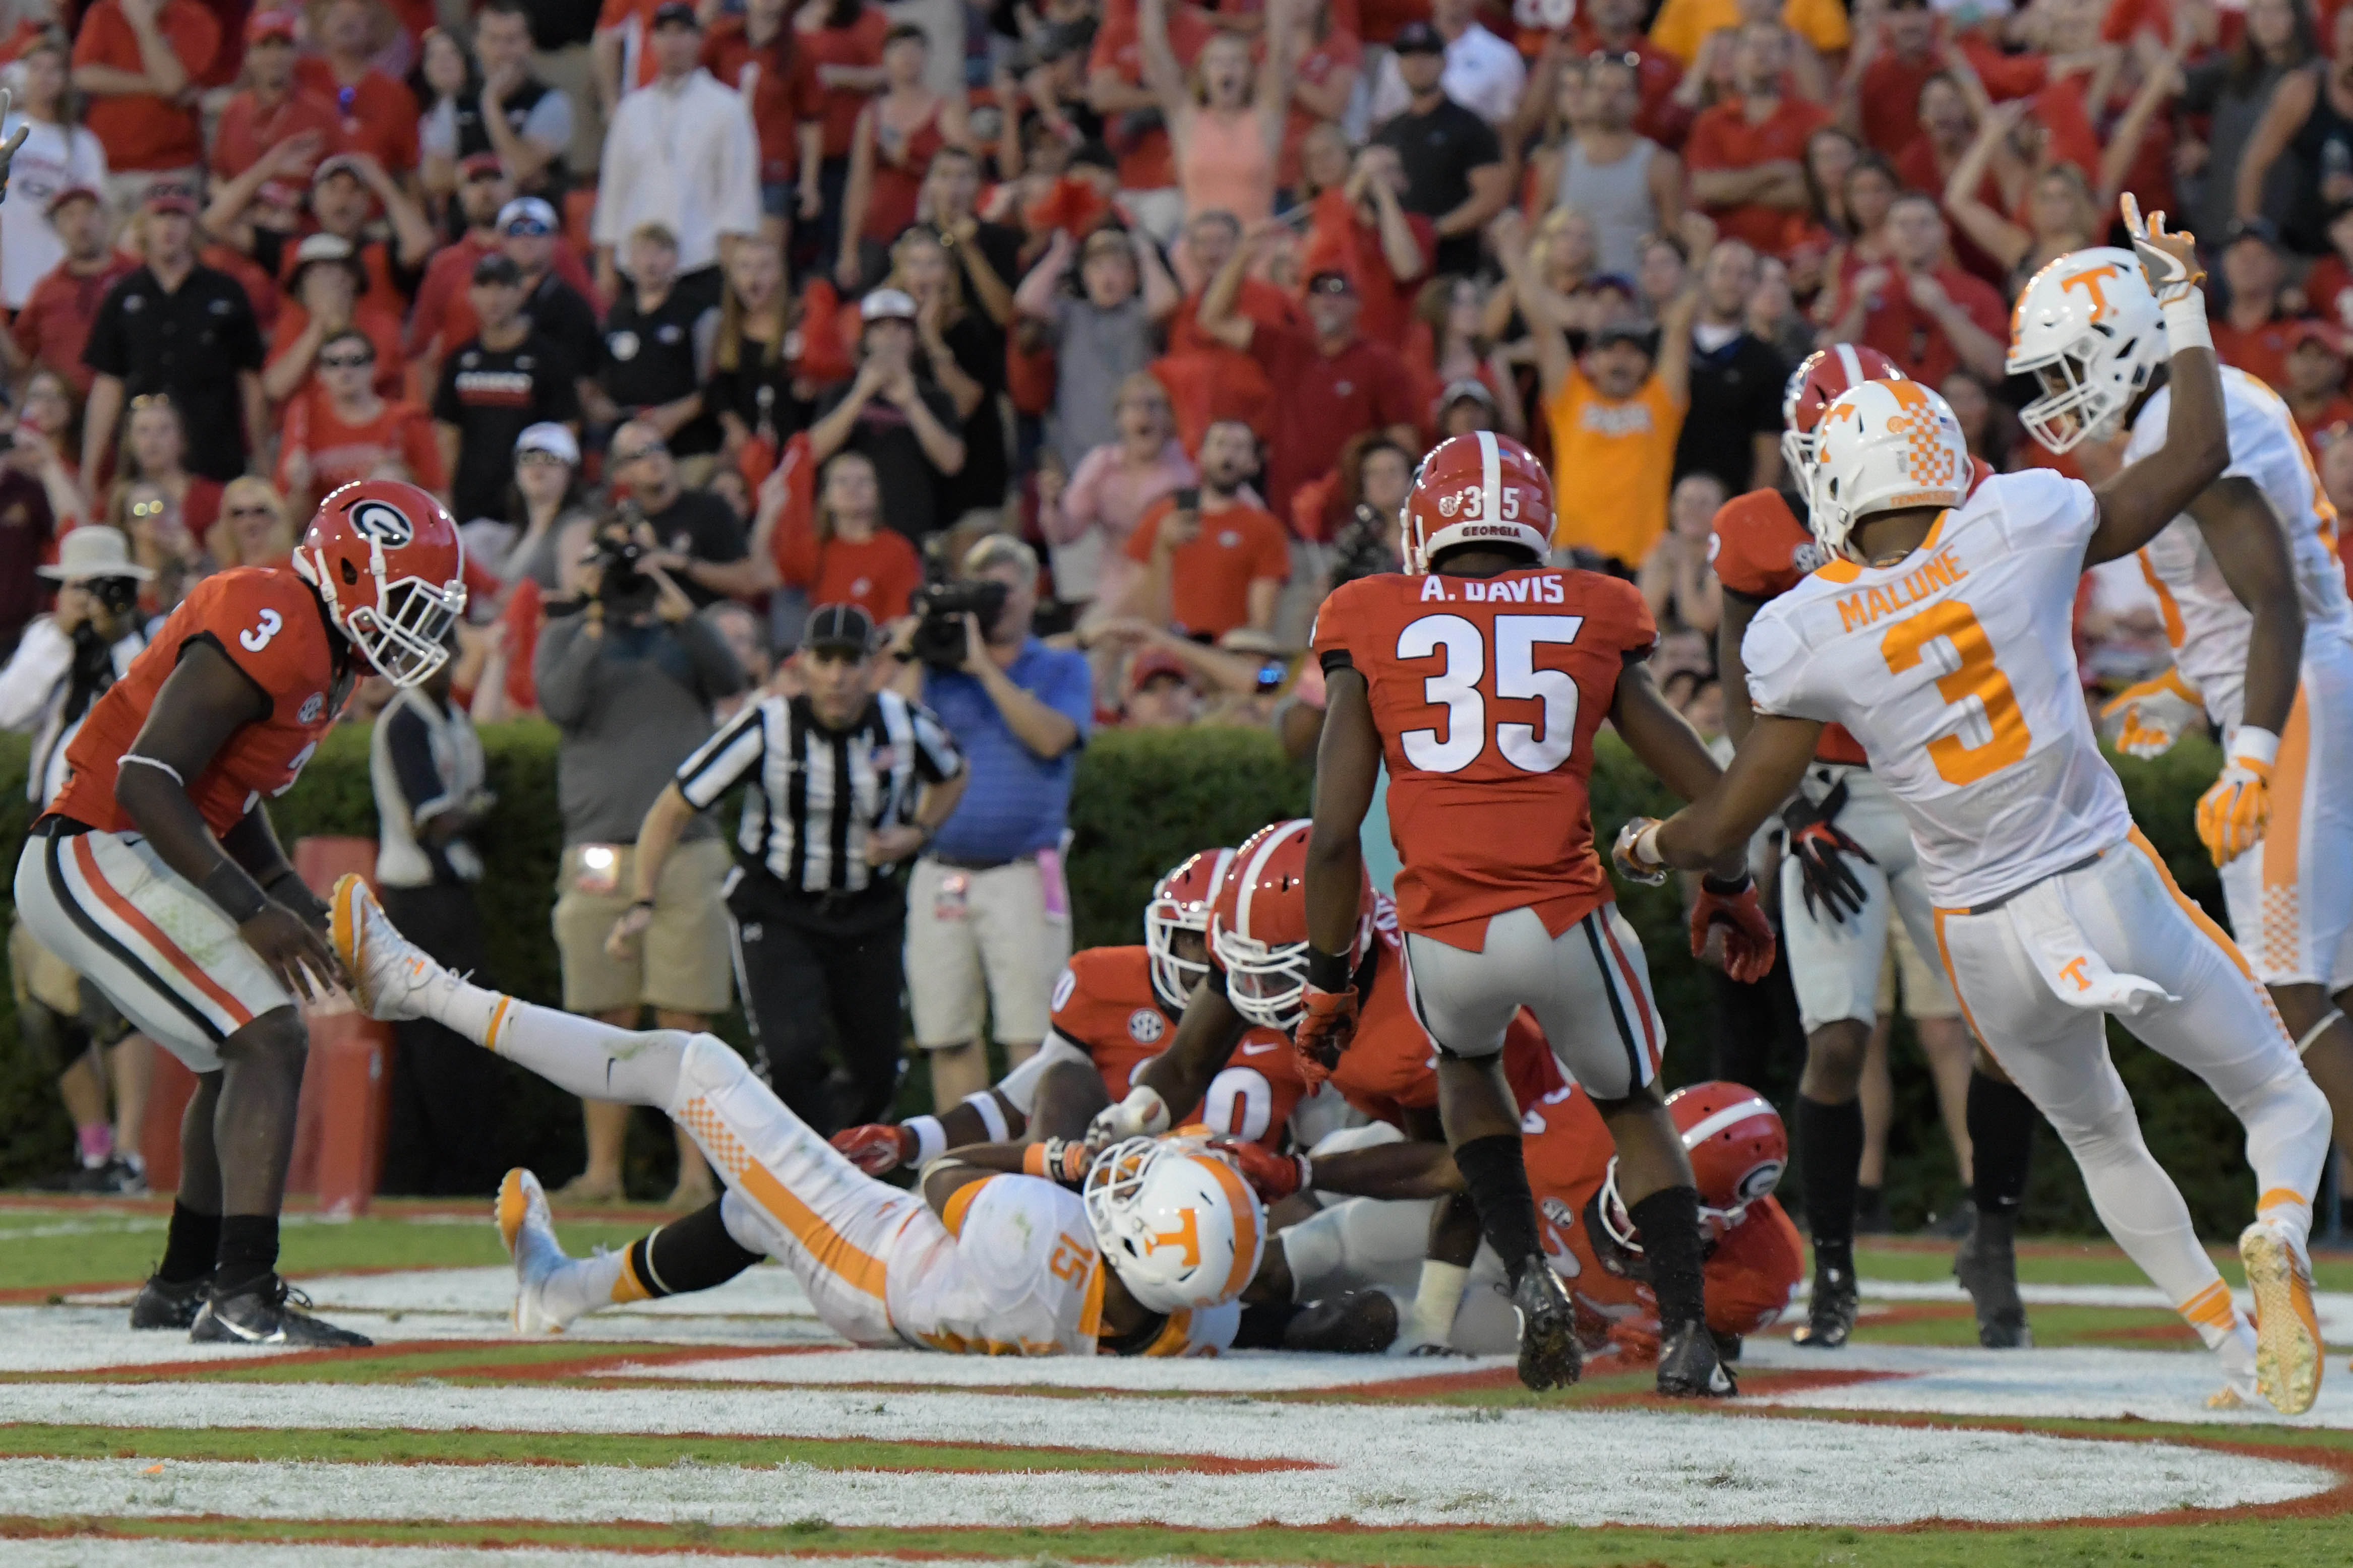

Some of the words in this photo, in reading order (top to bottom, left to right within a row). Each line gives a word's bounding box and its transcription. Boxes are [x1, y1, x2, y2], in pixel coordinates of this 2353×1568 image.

[2062, 265, 2118, 324] T
[1944, 449, 1955, 480] 3
[354, 502, 412, 546] G
[1462, 525, 1521, 538] GEORGIA
[1420, 574, 1456, 602] A.
[1464, 574, 1564, 603] DAVIS
[1836, 544, 1969, 634] MALONE
[239, 607, 283, 652] 3
[1396, 613, 1585, 773] 35
[1881, 599, 2032, 786] 3
[2059, 957, 2092, 991] T
[1050, 1232, 1094, 1291] 15
[1144, 1208, 1201, 1268] T
